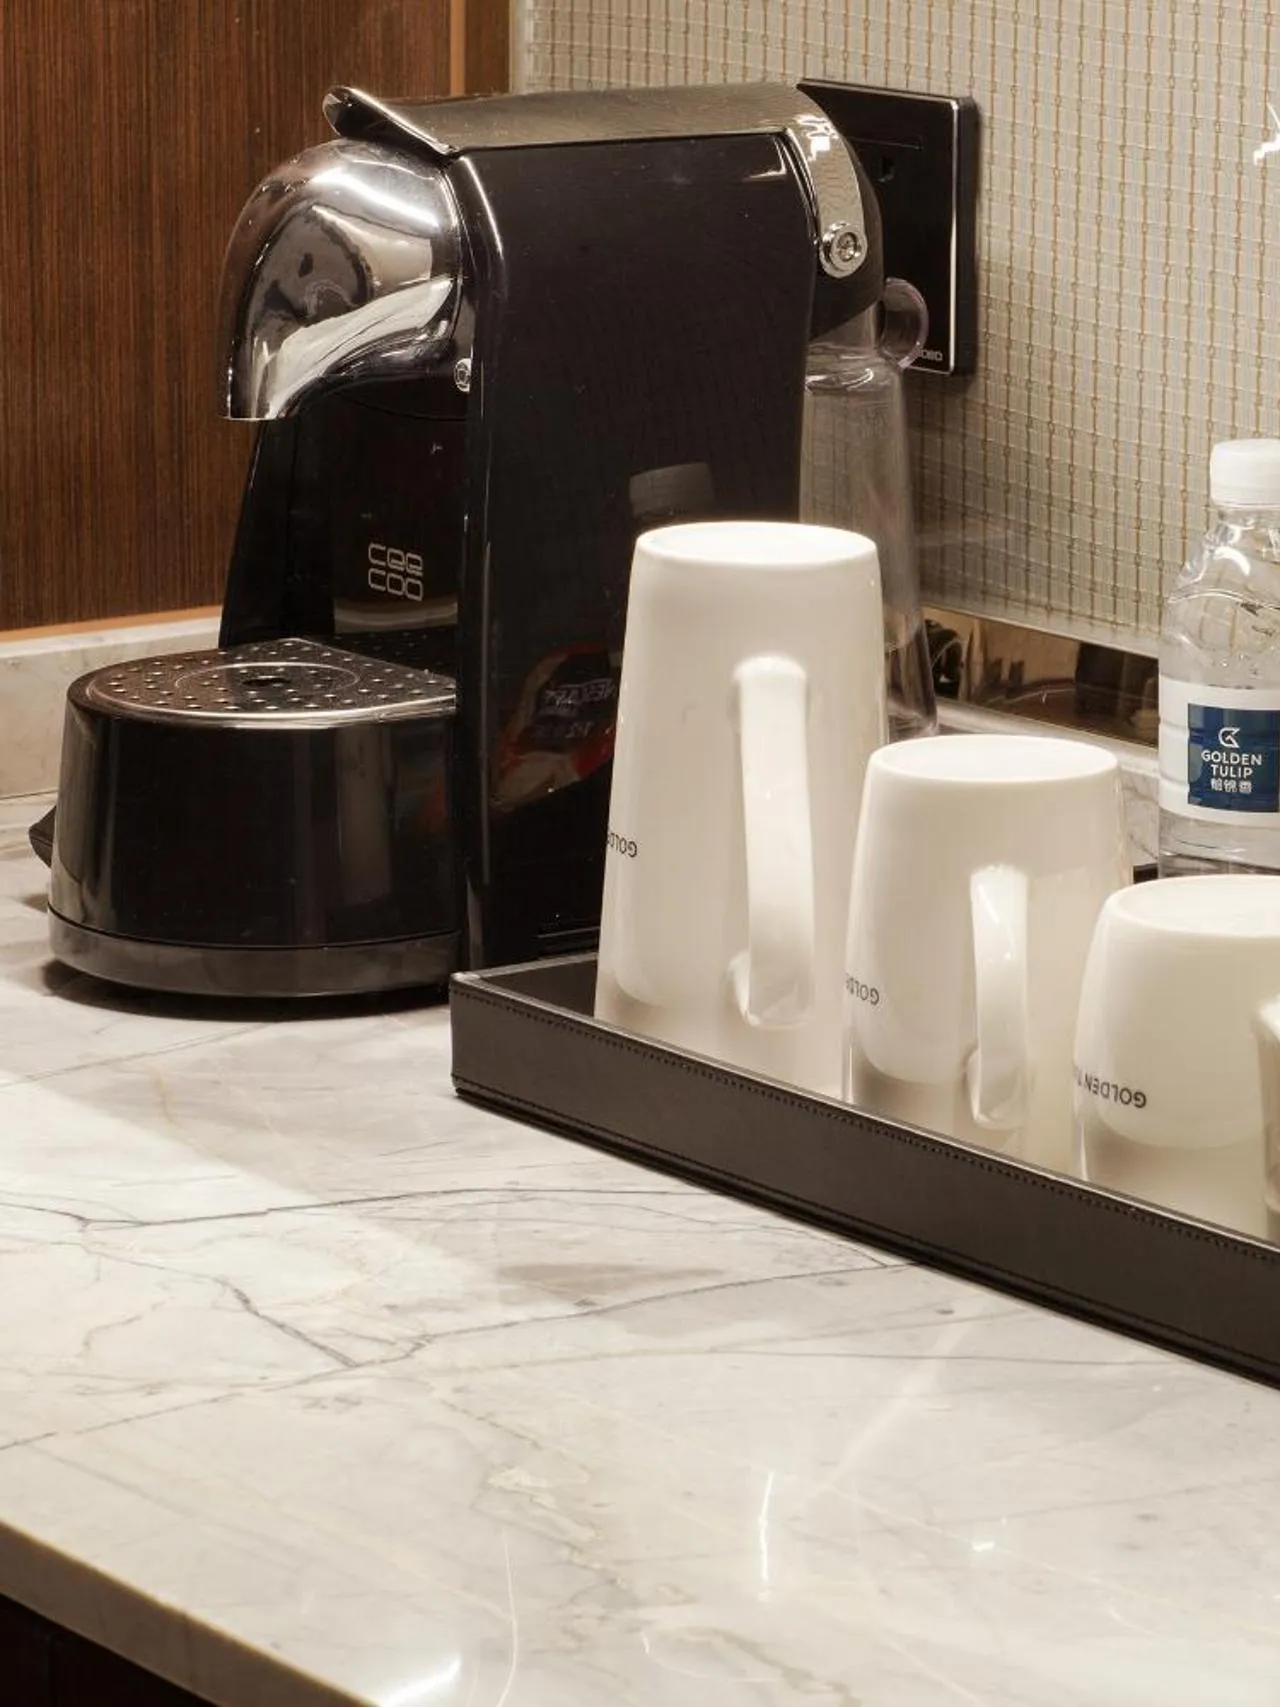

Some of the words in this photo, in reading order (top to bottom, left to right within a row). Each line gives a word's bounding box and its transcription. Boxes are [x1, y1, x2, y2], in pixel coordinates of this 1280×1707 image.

[1201, 750, 1262, 766] GOLDEN
[1210, 764, 1253, 779] TULIP
[1083, 1071, 1147, 1109] GOLDEN
